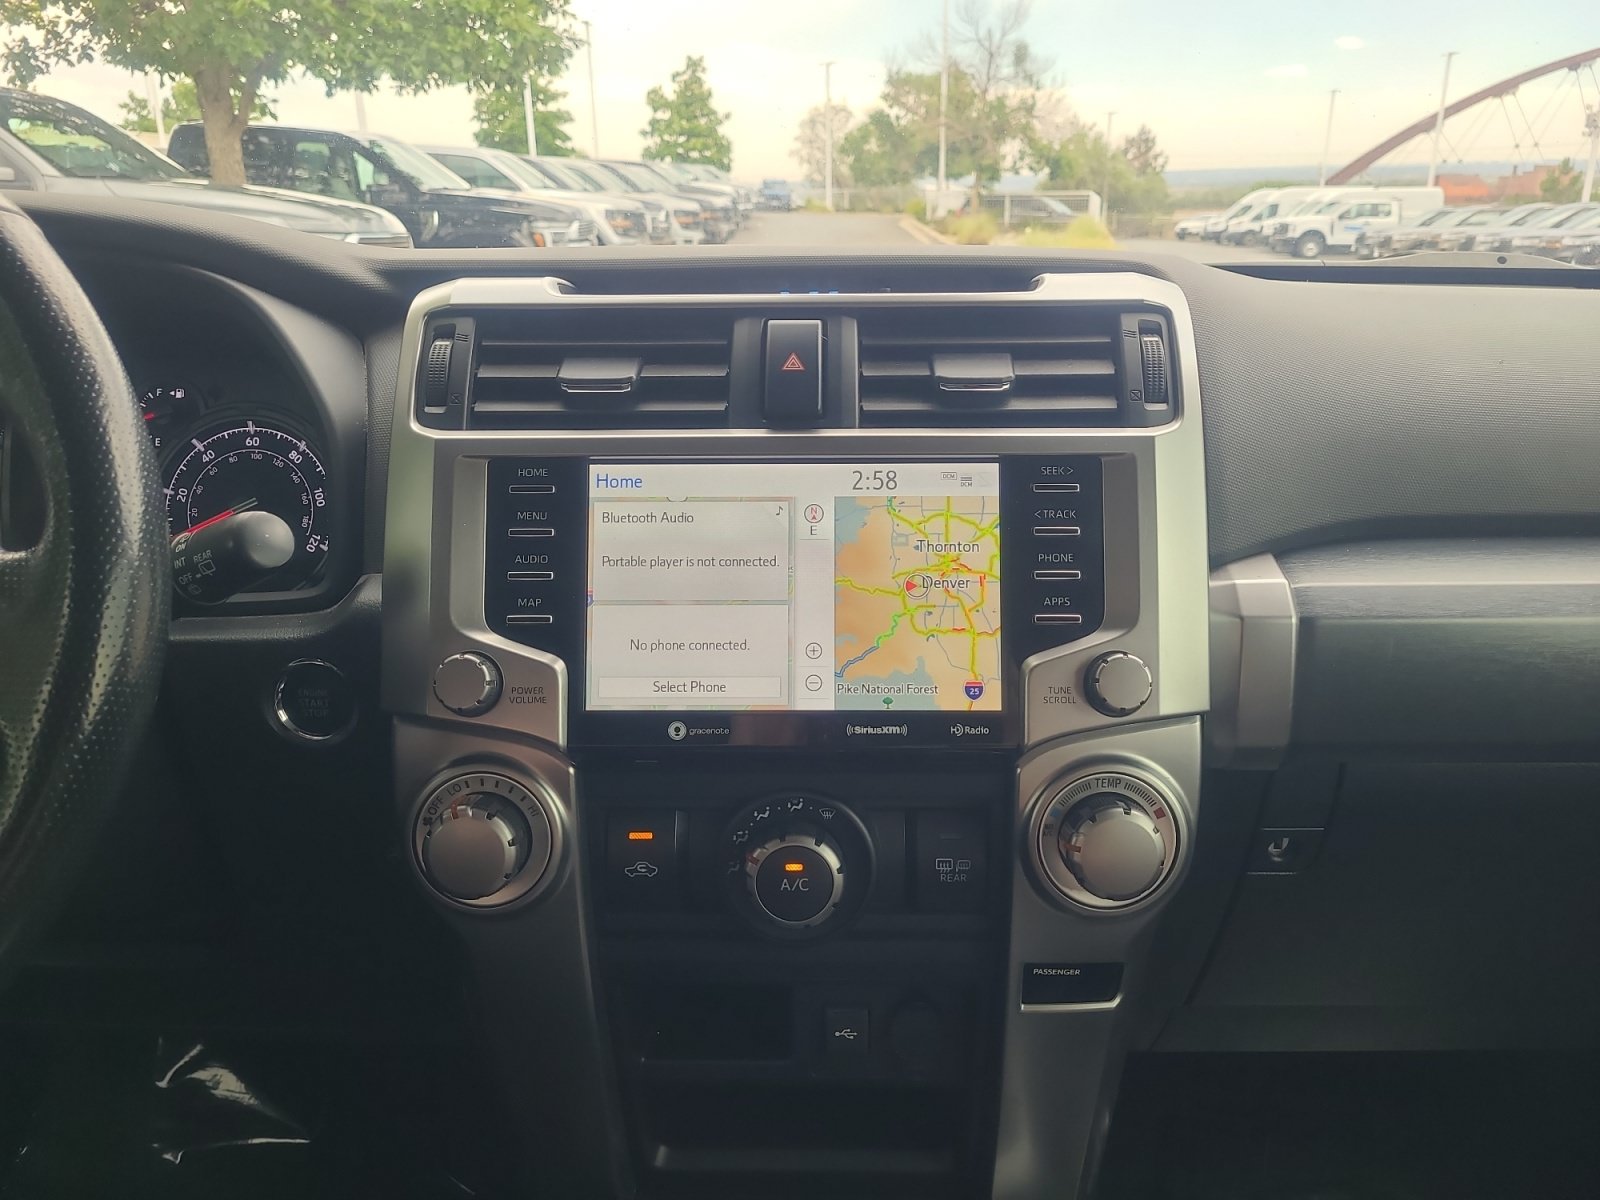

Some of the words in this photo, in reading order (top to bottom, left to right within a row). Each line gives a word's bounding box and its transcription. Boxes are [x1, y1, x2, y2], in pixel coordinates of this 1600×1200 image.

[156, 388, 163, 397] F
[155, 438, 161, 446] E
[245, 437, 260, 447] 60
[201, 450, 216, 463] 40
[288, 450, 303, 464] 80
[272, 457, 285, 468] 120
[289, 472, 301, 484] 140
[518, 468, 548, 477] HOME
[596, 474, 643, 489] Home
[851, 470, 898, 490] 2:58
[176, 487, 188, 503] 20
[301, 492, 309, 505] 160
[313, 487, 326, 508] 100
[191, 507, 198, 517] 20
[517, 512, 547, 520] MENU
[602, 512, 657, 523] Bluetooth
[660, 512, 694, 523] Audio
[810, 526, 817, 536] E
[306, 534, 321, 553] 120
[916, 540, 980, 552] Thornton
[174, 556, 186, 569] INT
[193, 550, 213, 564] REAR
[515, 555, 548, 564] AUDIO
[1038, 553, 1073, 562] PHONE
[602, 556, 647, 567] Portable
[650, 556, 684, 570] player
[686, 556, 695, 567] is
[697, 557, 716, 567] not
[718, 556, 780, 567] connected.
[178, 573, 193, 585] OFF
[922, 577, 971, 589] Denver
[517, 598, 542, 607] MAP
[1044, 597, 1070, 606] APPS
[630, 640, 647, 651] No
[650, 639, 685, 654] phone
[689, 639, 750, 651] connected.
[511, 686, 544, 695] POWER
[653, 681, 687, 693] Select
[690, 681, 726, 693] Phone
[837, 684, 860, 694] Pike
[861, 684, 905, 695] National
[907, 684, 939, 694] Forest
[1048, 686, 1072, 695] TUNE
[509, 696, 547, 704] VOLUME
[1043, 696, 1076, 704] SCROLL
[689, 726, 730, 736] gracenote
[965, 725, 989, 735] Radio
[1094, 778, 1122, 789] TEMP
[447, 784, 462, 796] LO
[429, 797, 443, 816] OFF
[527, 806, 540, 817] HI
[940, 873, 967, 882] REAR
[780, 878, 809, 892] A/C
[1033, 968, 1081, 976] PASSENGER
